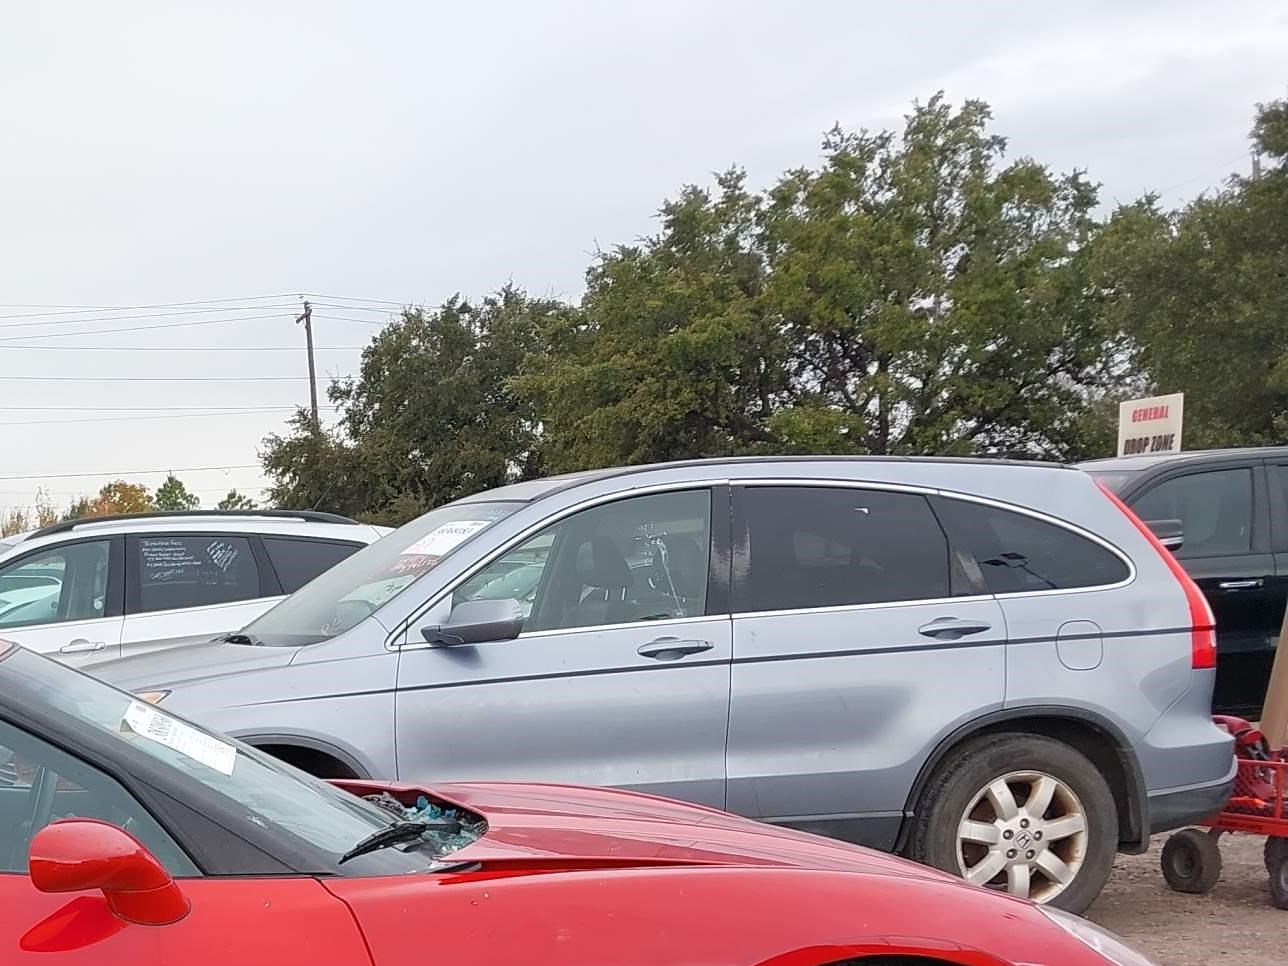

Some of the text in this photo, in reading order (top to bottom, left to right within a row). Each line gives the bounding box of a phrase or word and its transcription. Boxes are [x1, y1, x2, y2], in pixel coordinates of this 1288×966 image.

[1132, 405, 1169, 422] GENERAL
[1123, 434, 1175, 455] DROP ZONE
